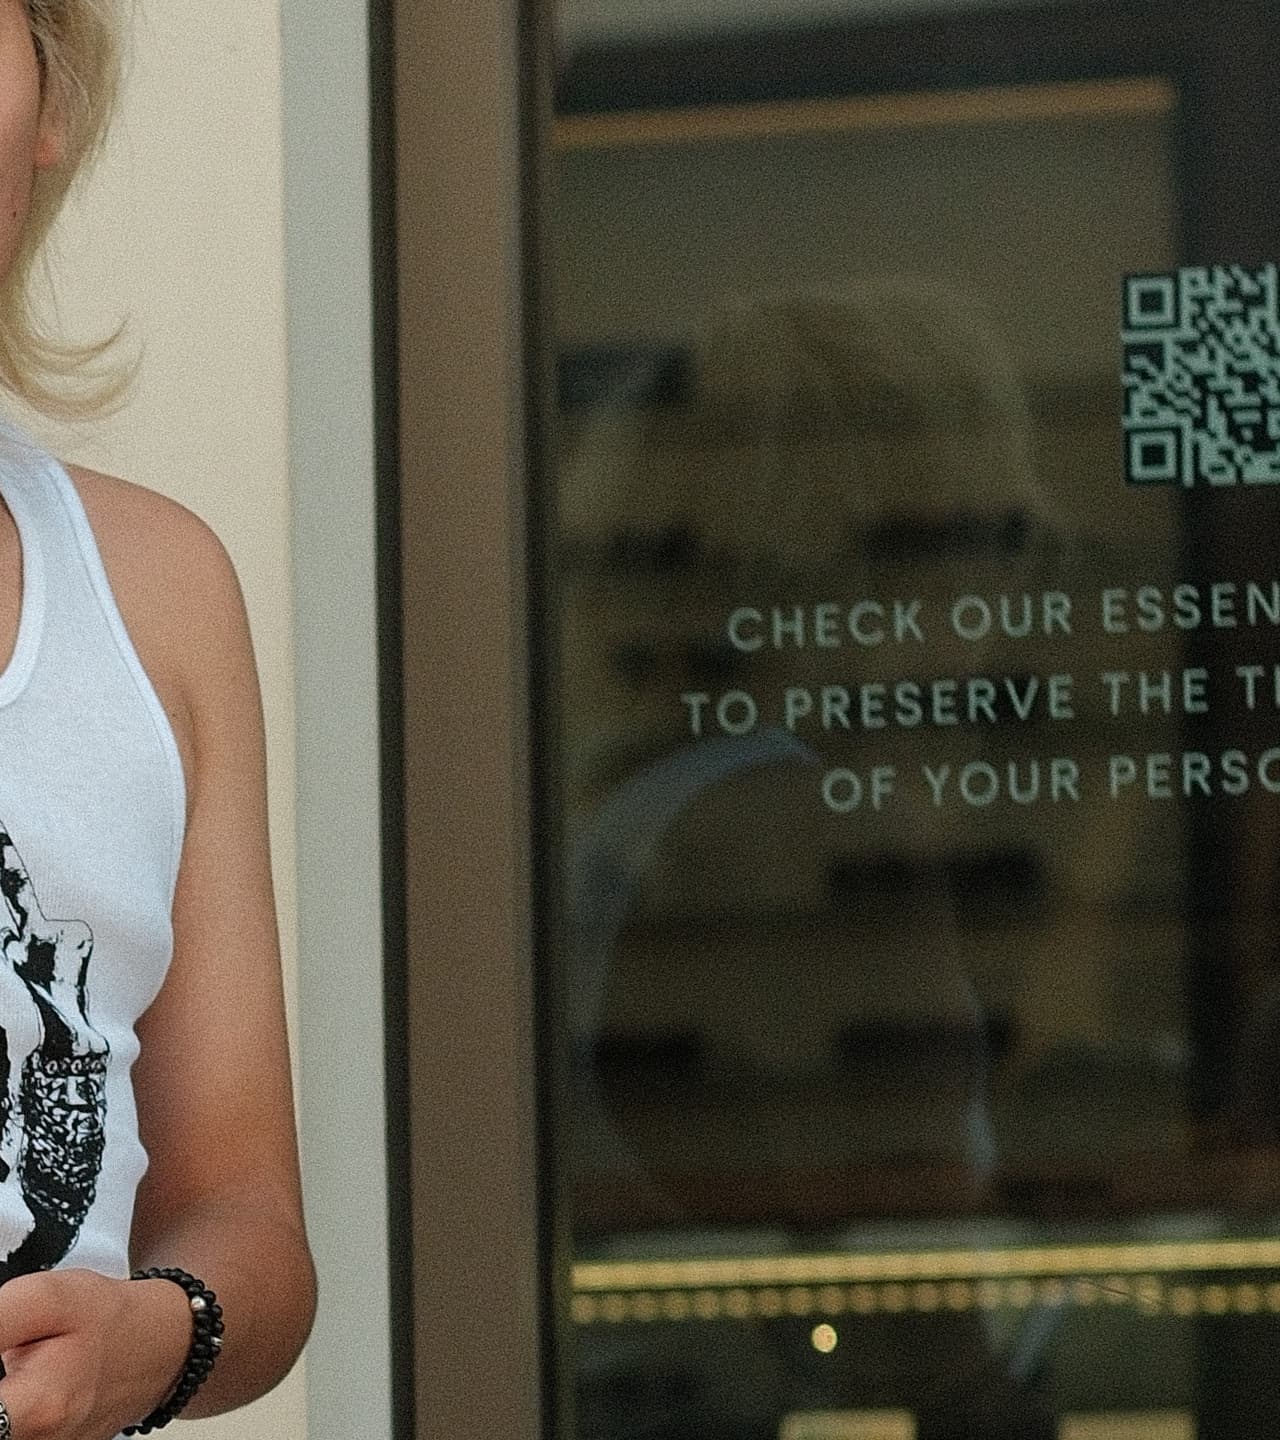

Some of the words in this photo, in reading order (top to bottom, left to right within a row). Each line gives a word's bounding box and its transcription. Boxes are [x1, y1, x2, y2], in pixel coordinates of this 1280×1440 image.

[727, 598, 924, 652] CHECK
[951, 591, 1072, 640] OUR
[1102, 581, 1280, 632] ESSEN
[682, 690, 758, 735] TO
[785, 675, 1075, 730] PRESERVE
[1102, 668, 1209, 715] THE
[1236, 664, 1280, 711] T
[821, 766, 896, 813] OF
[924, 758, 1079, 807] YOUR
